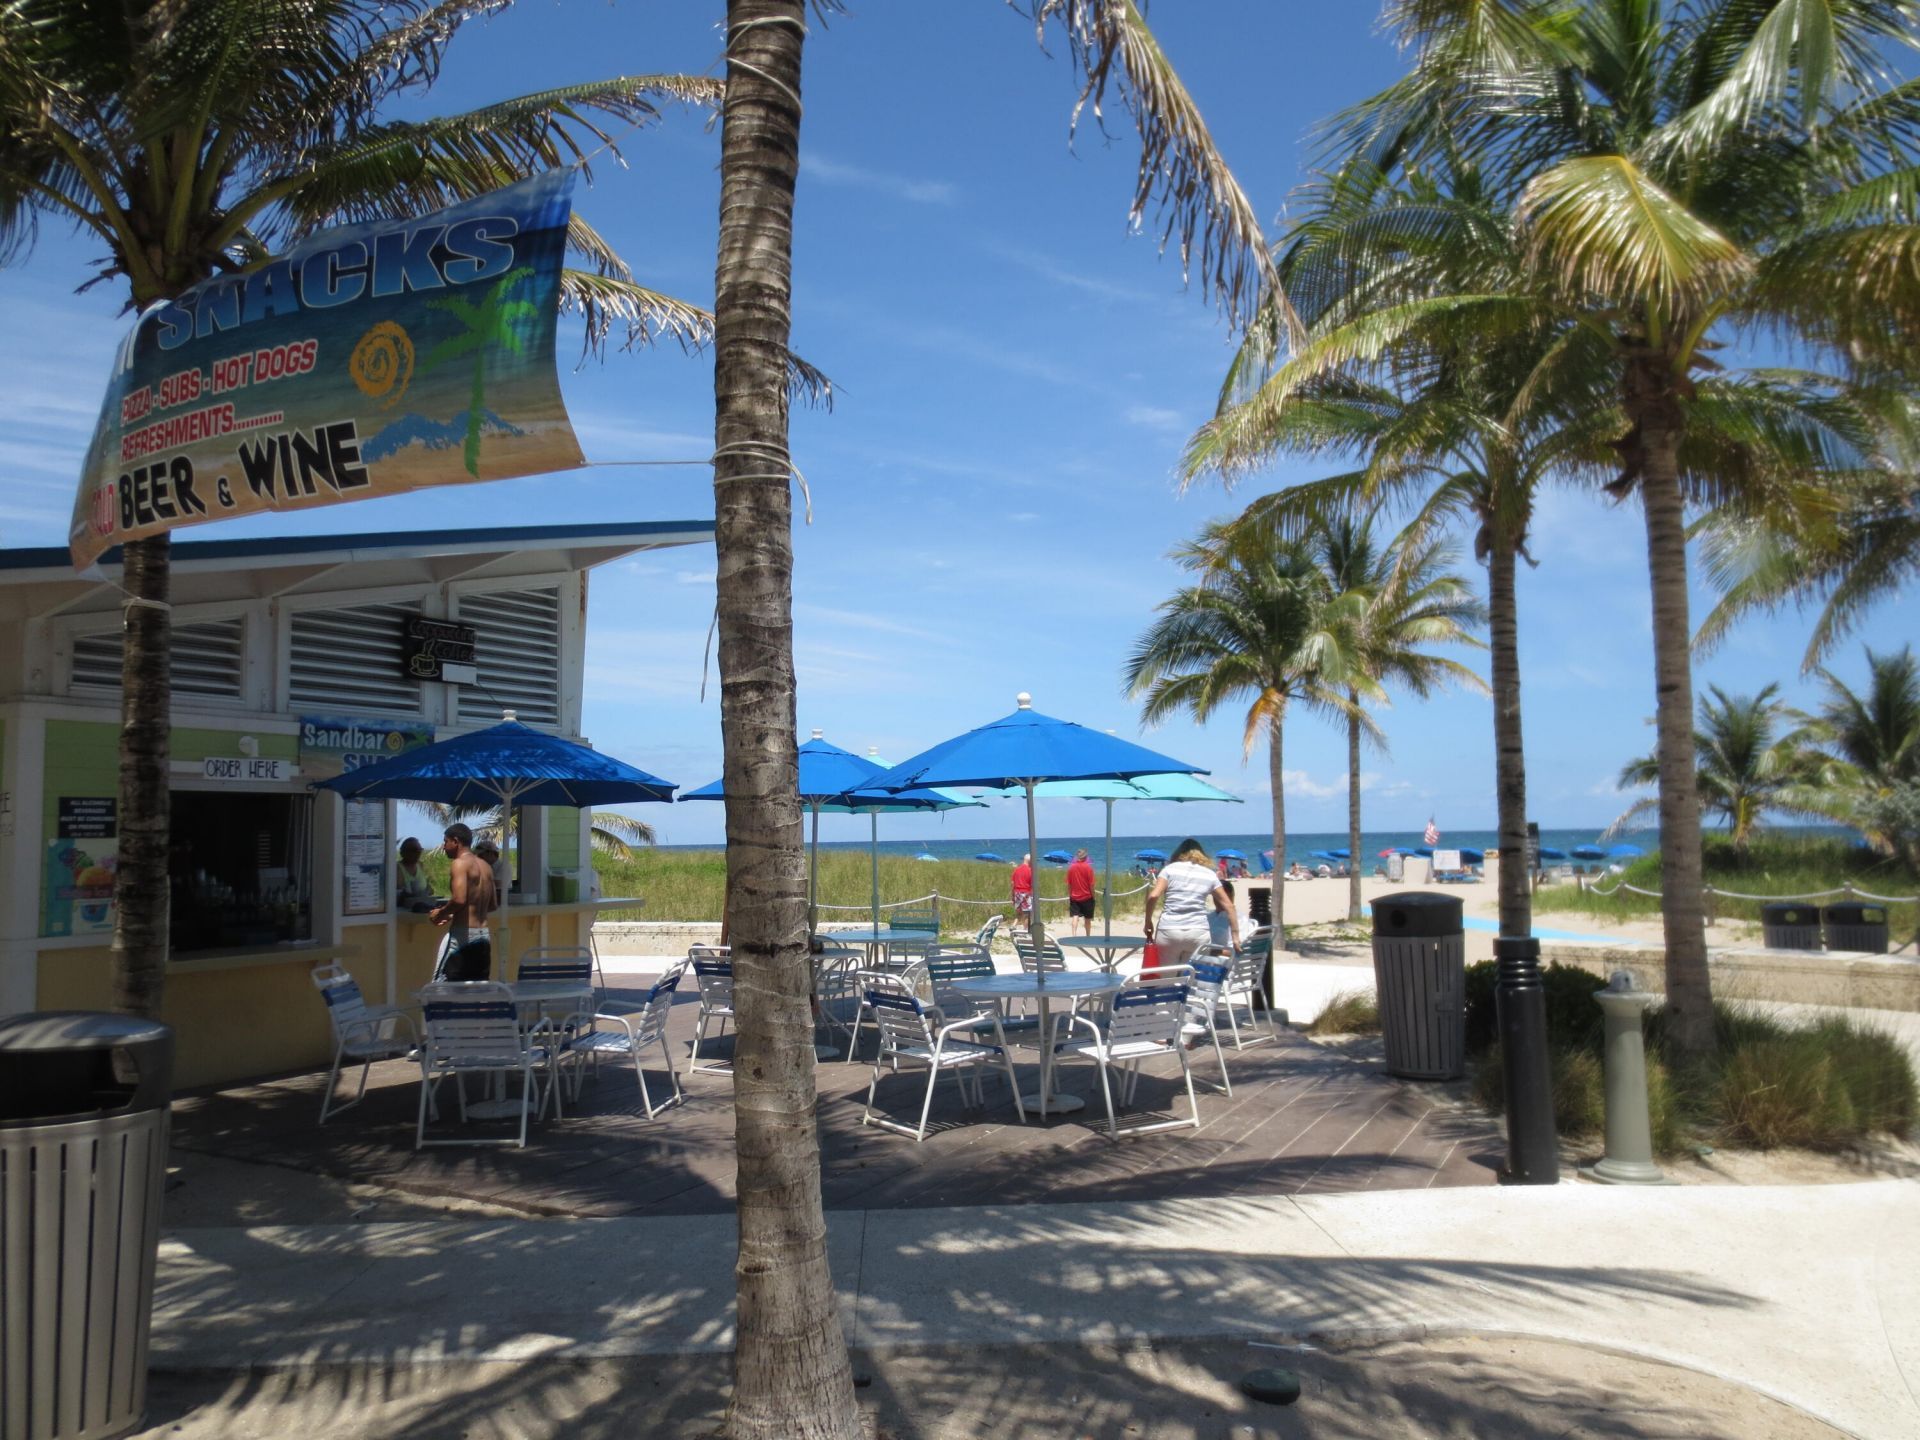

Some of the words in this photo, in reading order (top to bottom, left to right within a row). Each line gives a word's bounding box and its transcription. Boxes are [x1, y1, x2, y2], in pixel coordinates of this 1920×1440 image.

[157, 217, 519, 351] SNACKS
[121, 386, 152, 427] PIZZA
[160, 367, 201, 410] SUBS
[212, 352, 253, 395] HOT
[254, 339, 319, 384] DOGS
[119, 455, 208, 531] BEER
[216, 475, 237, 509] &
[238, 419, 371, 502] WINE
[205, 759, 242, 778] ORDER
[250, 760, 280, 779] HERE
[304, 723, 386, 750] Sandbar
